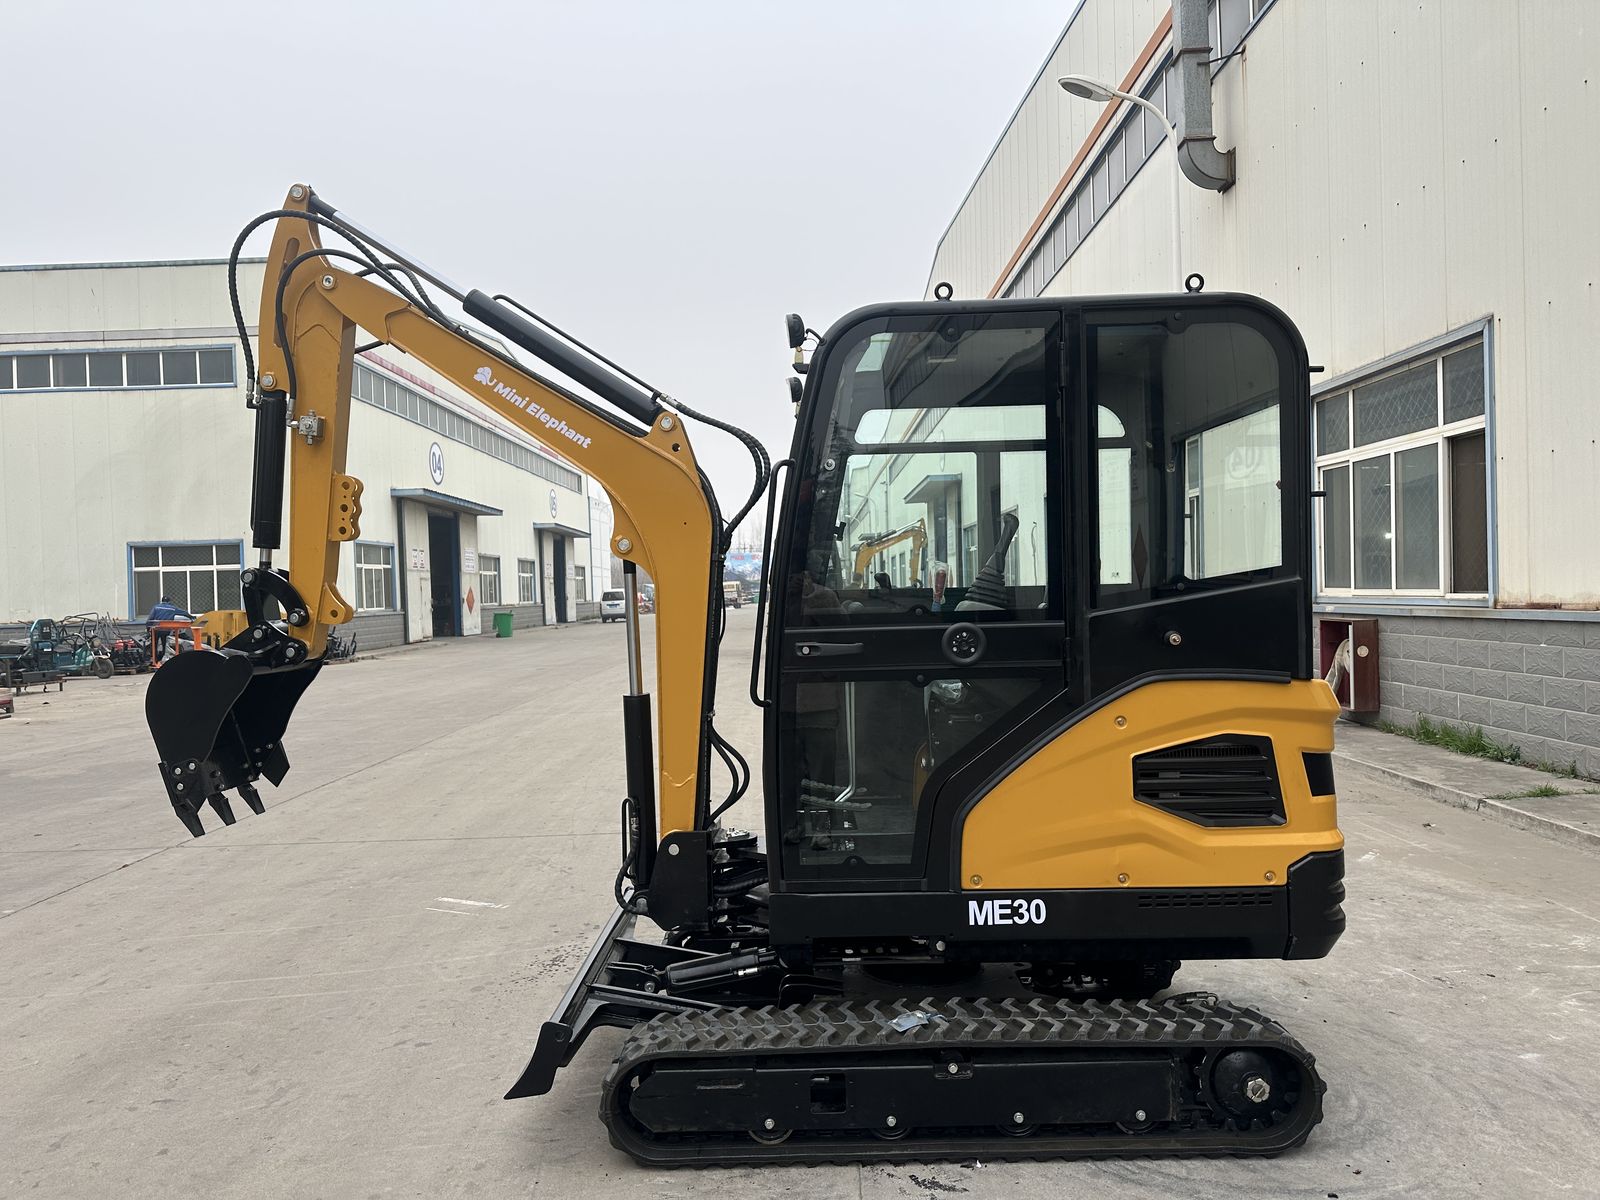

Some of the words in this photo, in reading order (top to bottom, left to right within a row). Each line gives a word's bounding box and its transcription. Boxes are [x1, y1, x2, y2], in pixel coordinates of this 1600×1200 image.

[494, 382, 529, 409] Mini
[526, 403, 592, 448] Elephant
[431, 451, 443, 476] 04
[968, 898, 1047, 926] ME30
